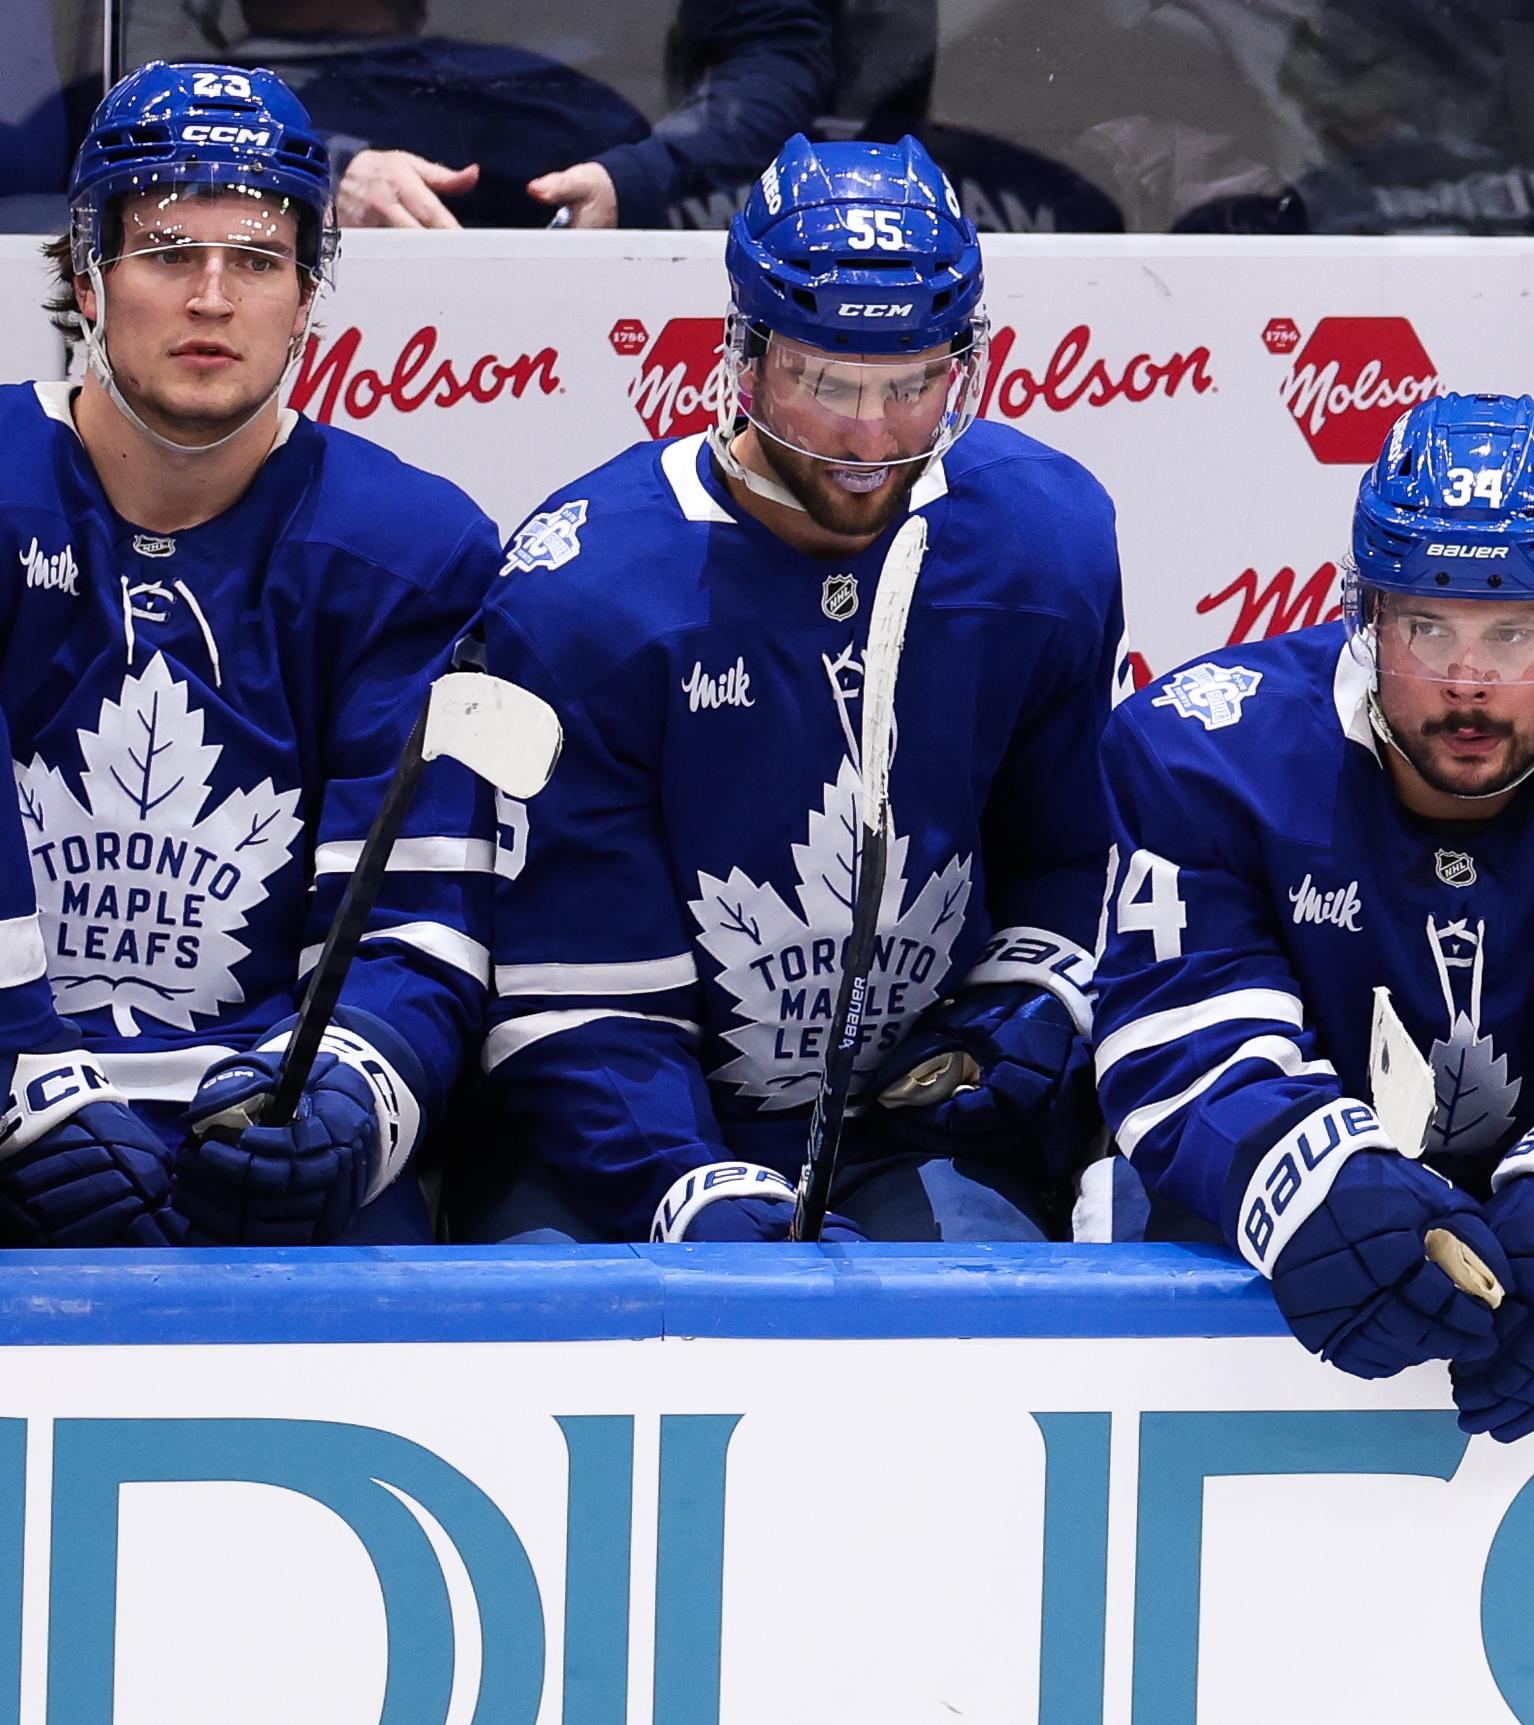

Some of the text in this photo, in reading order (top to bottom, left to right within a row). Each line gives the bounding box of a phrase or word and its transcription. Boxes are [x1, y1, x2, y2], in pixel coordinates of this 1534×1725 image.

[192, 73, 251, 98] 23
[182, 125, 270, 146] CCM
[846, 209, 904, 250] 55
[838, 303, 913, 317] CCM
[1280, 359, 1441, 436] Molson
[1443, 467, 1504, 509] 34
[19, 537, 79, 596] Milk
[1426, 543, 1509, 559] BAUER
[828, 585, 855, 611] NHL
[682, 655, 755, 713] Milk
[32, 831, 241, 902] TORONTO
[62, 881, 206, 928] MAPLE
[1095, 843, 1188, 964] 4
[1289, 874, 1363, 932] Milk
[57, 922, 200, 970] LEAFS
[780, 982, 909, 1021] MALE
[845, 976, 867, 1038] BAUER
[774, 1021, 900, 1059] LEFS
[202, 1071, 254, 1089] CCM
[1245, 1105, 1380, 1262] BAUE
